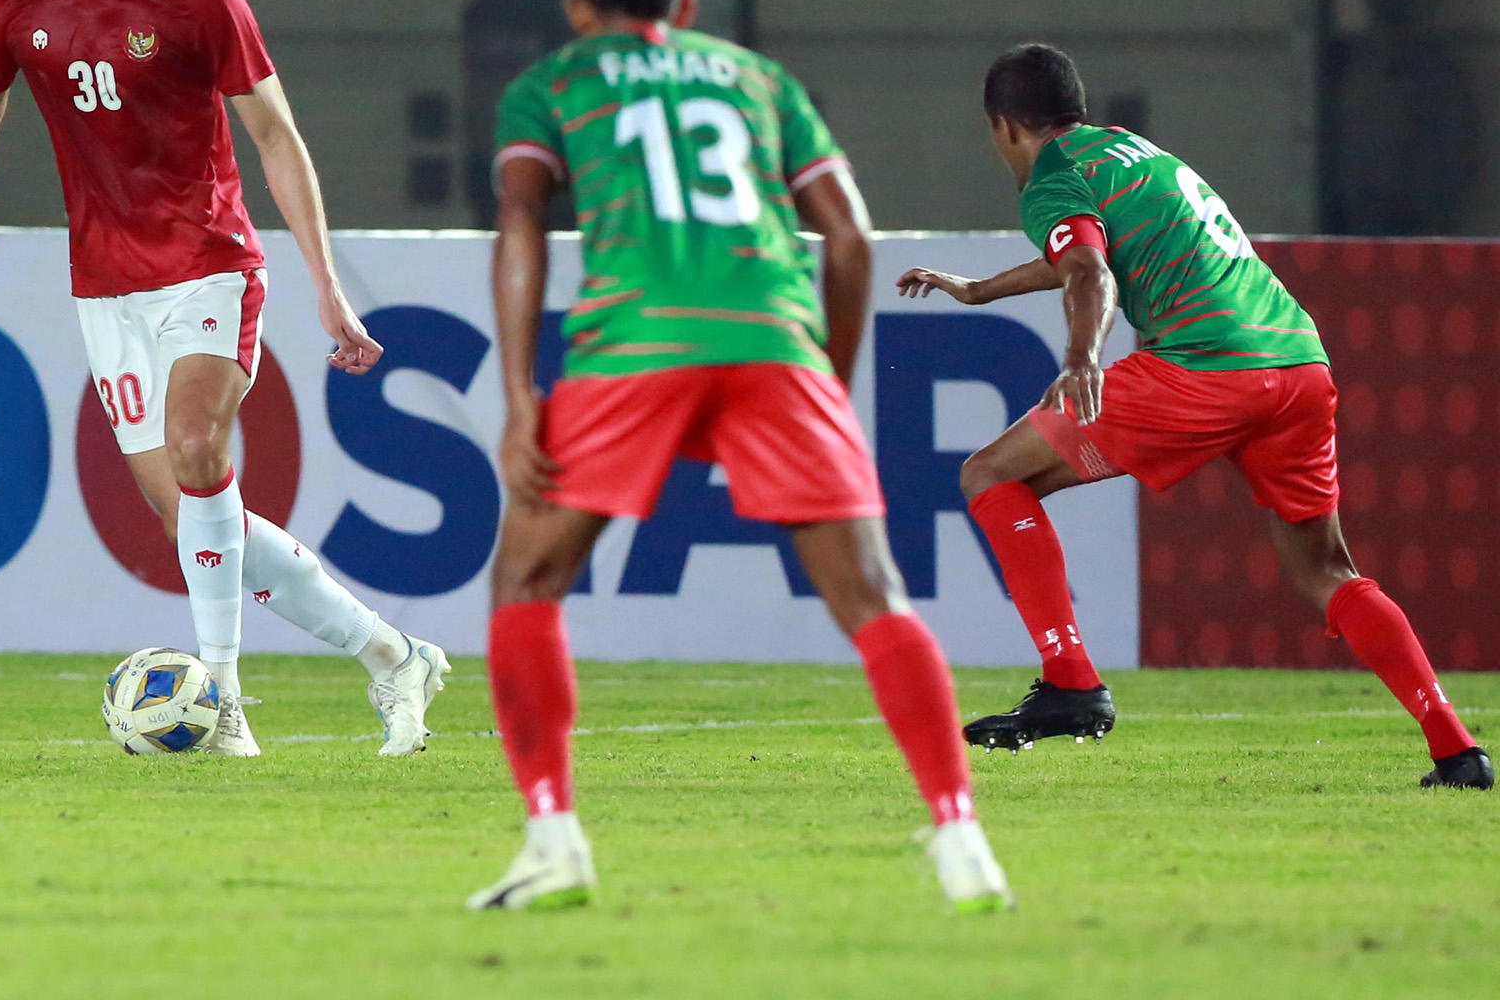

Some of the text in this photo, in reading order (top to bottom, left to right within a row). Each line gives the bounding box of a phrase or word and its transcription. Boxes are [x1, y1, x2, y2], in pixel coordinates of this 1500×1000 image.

[68, 60, 121, 113] 30
[614, 96, 761, 225] 13
[1049, 224, 1073, 253] C
[99, 372, 146, 429] 30
